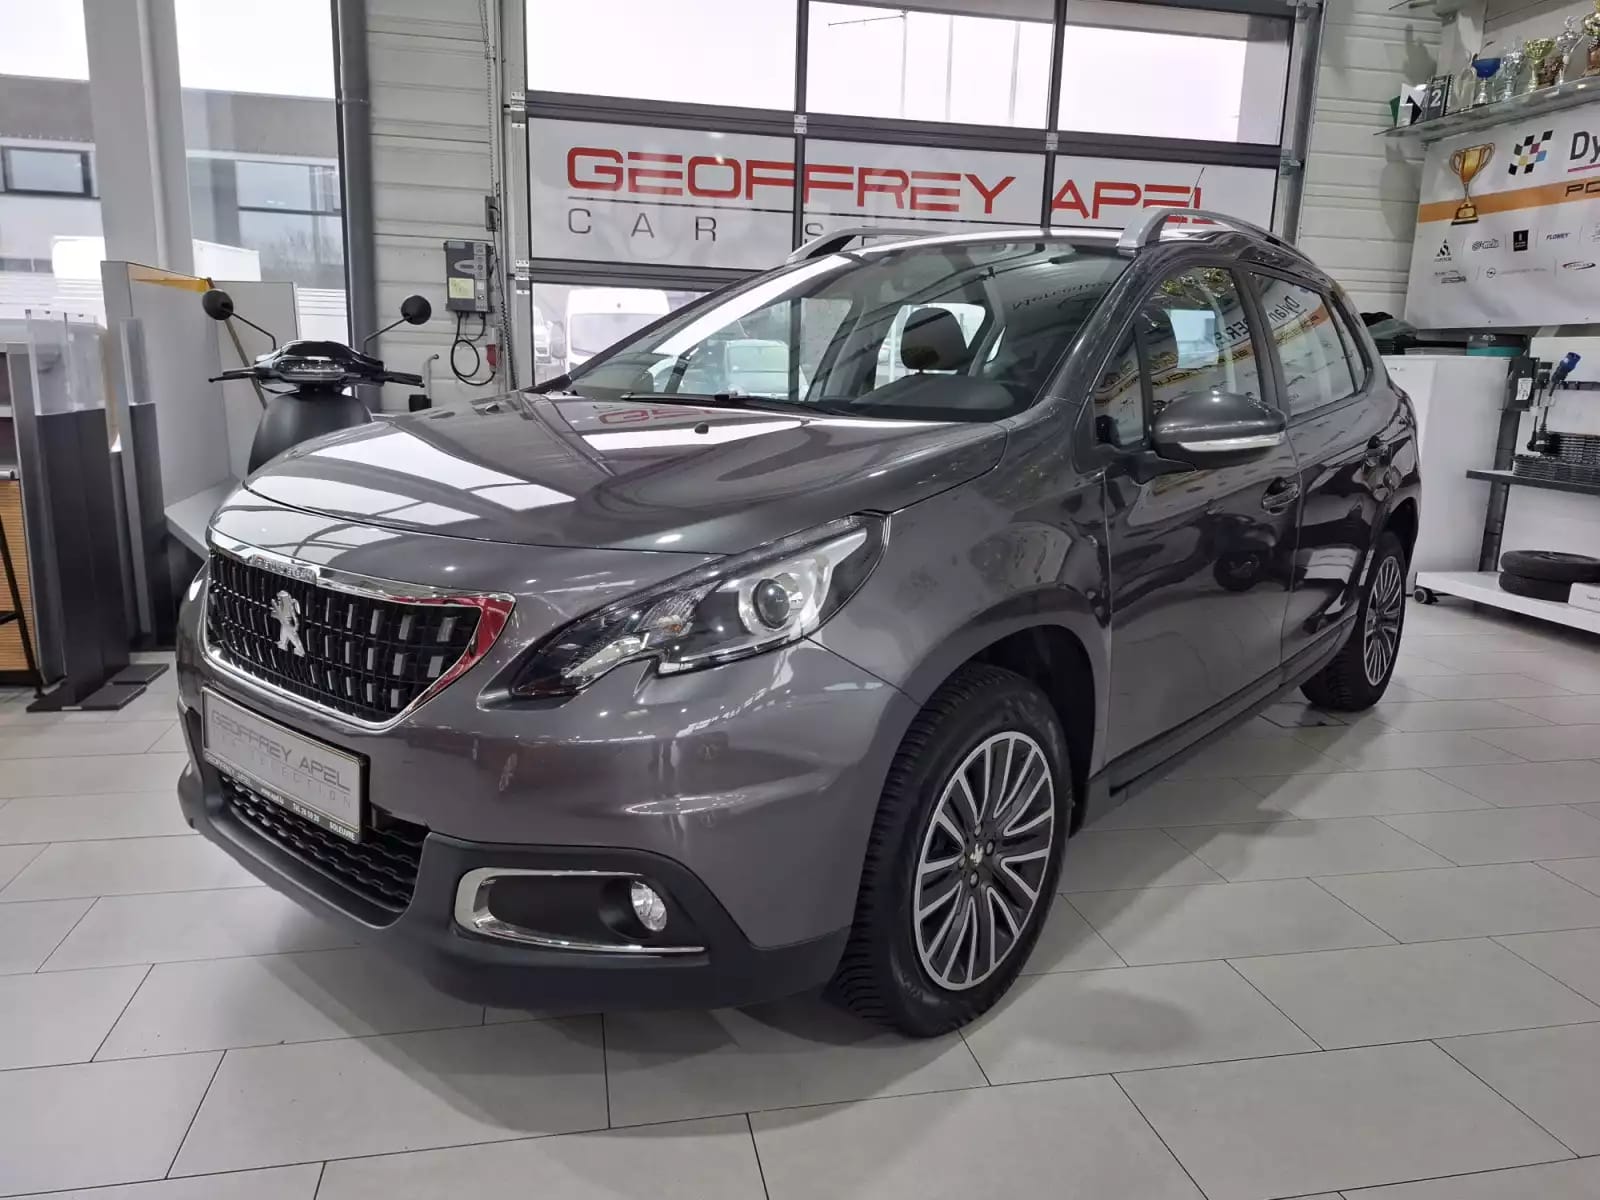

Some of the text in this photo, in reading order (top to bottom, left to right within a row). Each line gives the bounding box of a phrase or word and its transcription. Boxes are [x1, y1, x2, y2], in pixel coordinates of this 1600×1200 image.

[1430, 89, 1442, 107] 2
[567, 147, 1214, 225] GEOFFREY APEL
[300, 756, 351, 792] APEL
